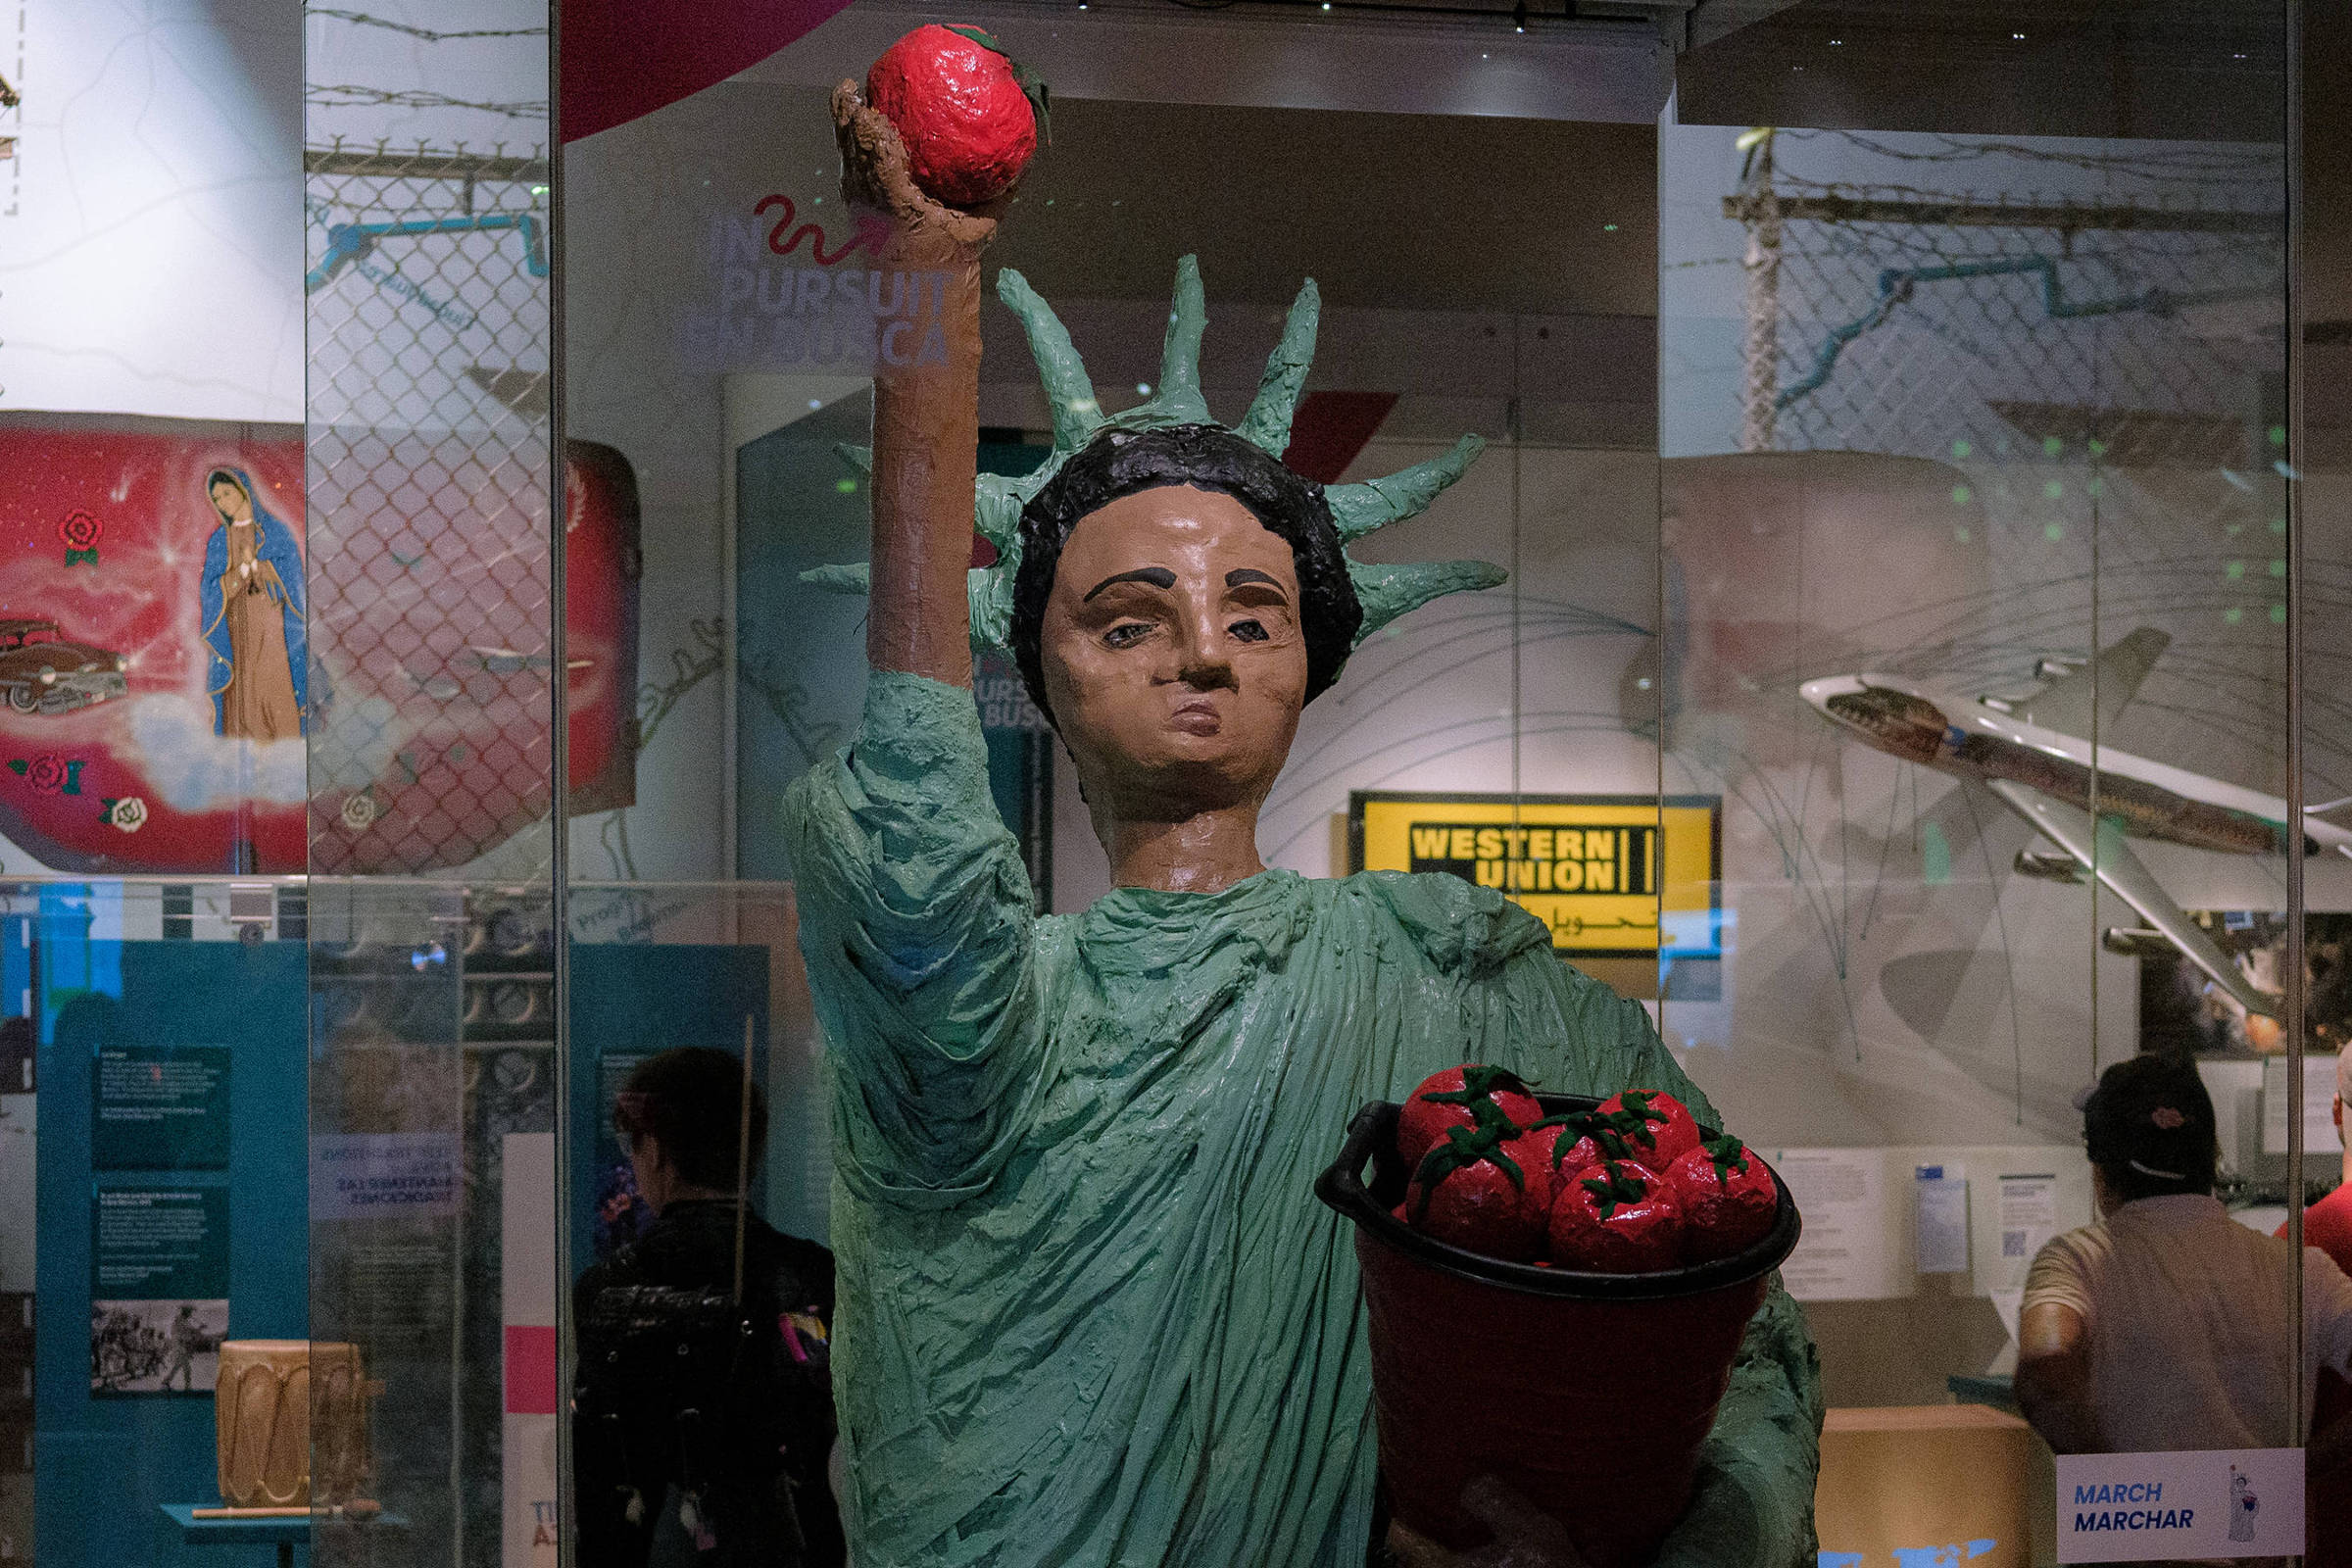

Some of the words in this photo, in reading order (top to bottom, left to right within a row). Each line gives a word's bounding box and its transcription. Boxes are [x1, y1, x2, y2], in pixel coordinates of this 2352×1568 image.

[721, 268, 955, 317] PURSUIT
[1411, 827, 1615, 860] WESTERN
[1475, 859, 1615, 892] UNION
[2074, 1483, 2163, 1504] MARCH
[2074, 1509, 2194, 1532] MARCHAR
